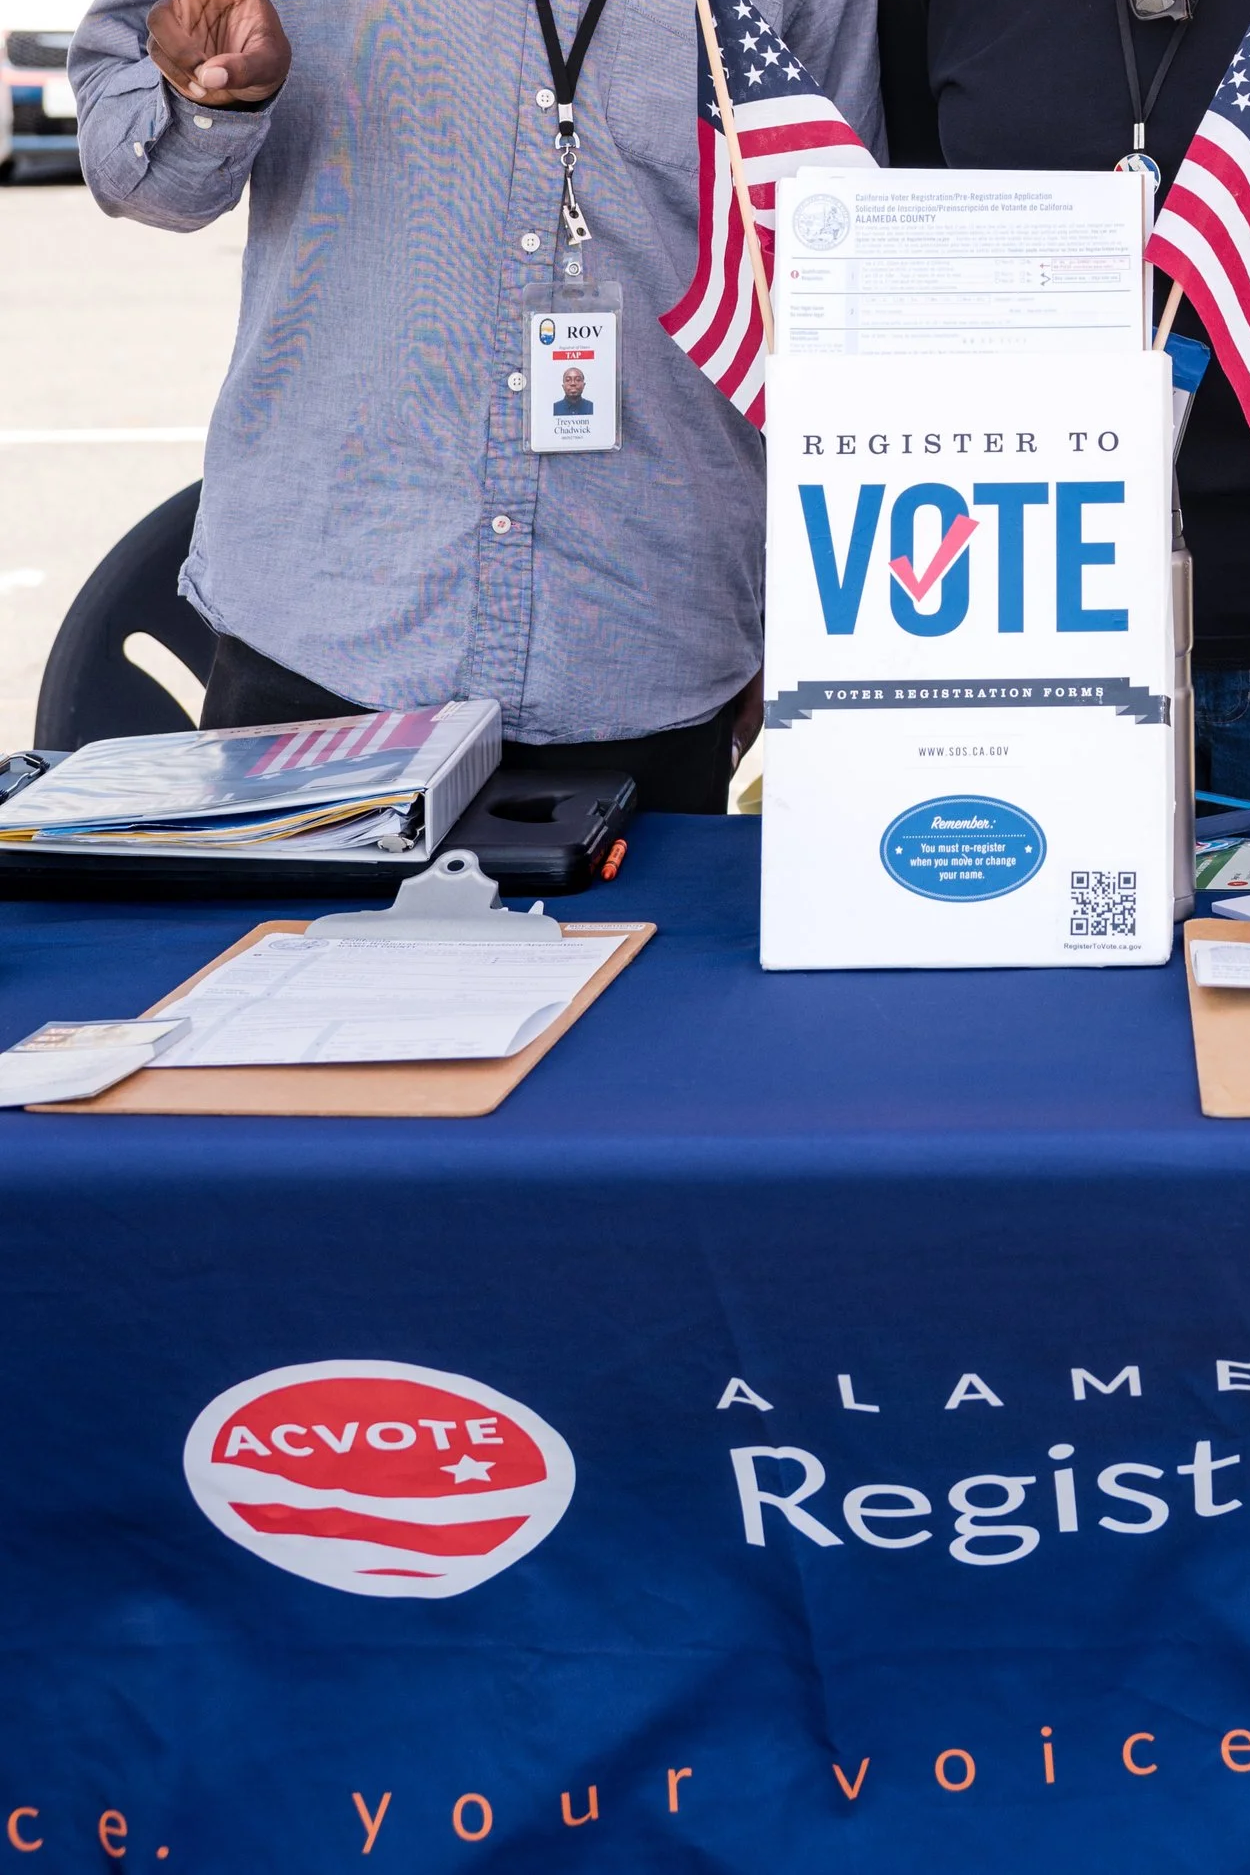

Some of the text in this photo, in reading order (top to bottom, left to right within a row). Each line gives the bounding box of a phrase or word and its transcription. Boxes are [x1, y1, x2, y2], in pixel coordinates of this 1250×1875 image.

[855, 192, 1052, 203] California Voter Registration/Pre-Registration Application
[855, 204, 885, 212] Solicitud
[991, 204, 999, 212] de
[1001, 203, 1027, 212] Votante
[1040, 202, 1073, 212] California
[855, 213, 936, 223] ALAMEDA COUNTY
[567, 325, 603, 339] ROV
[565, 351, 582, 360] TAP
[554, 425, 591, 435] Chadwick
[802, 431, 1120, 455] REGISTER TO
[798, 480, 1130, 637] VOTE
[823, 686, 1105, 700] VOTER REGISTRATION FORMS
[918, 746, 1009, 757] WWW.SOS.CA.GOV
[930, 815, 996, 829] Remember:
[920, 842, 1006, 854] You must re-register
[910, 856, 1017, 868] when you move or change
[939, 870, 985, 881] your name.
[1063, 942, 1142, 952] RegisterToVote.ca.gov
[224, 1416, 504, 1459] ACVOTE
[352, 1767, 692, 1854] your
